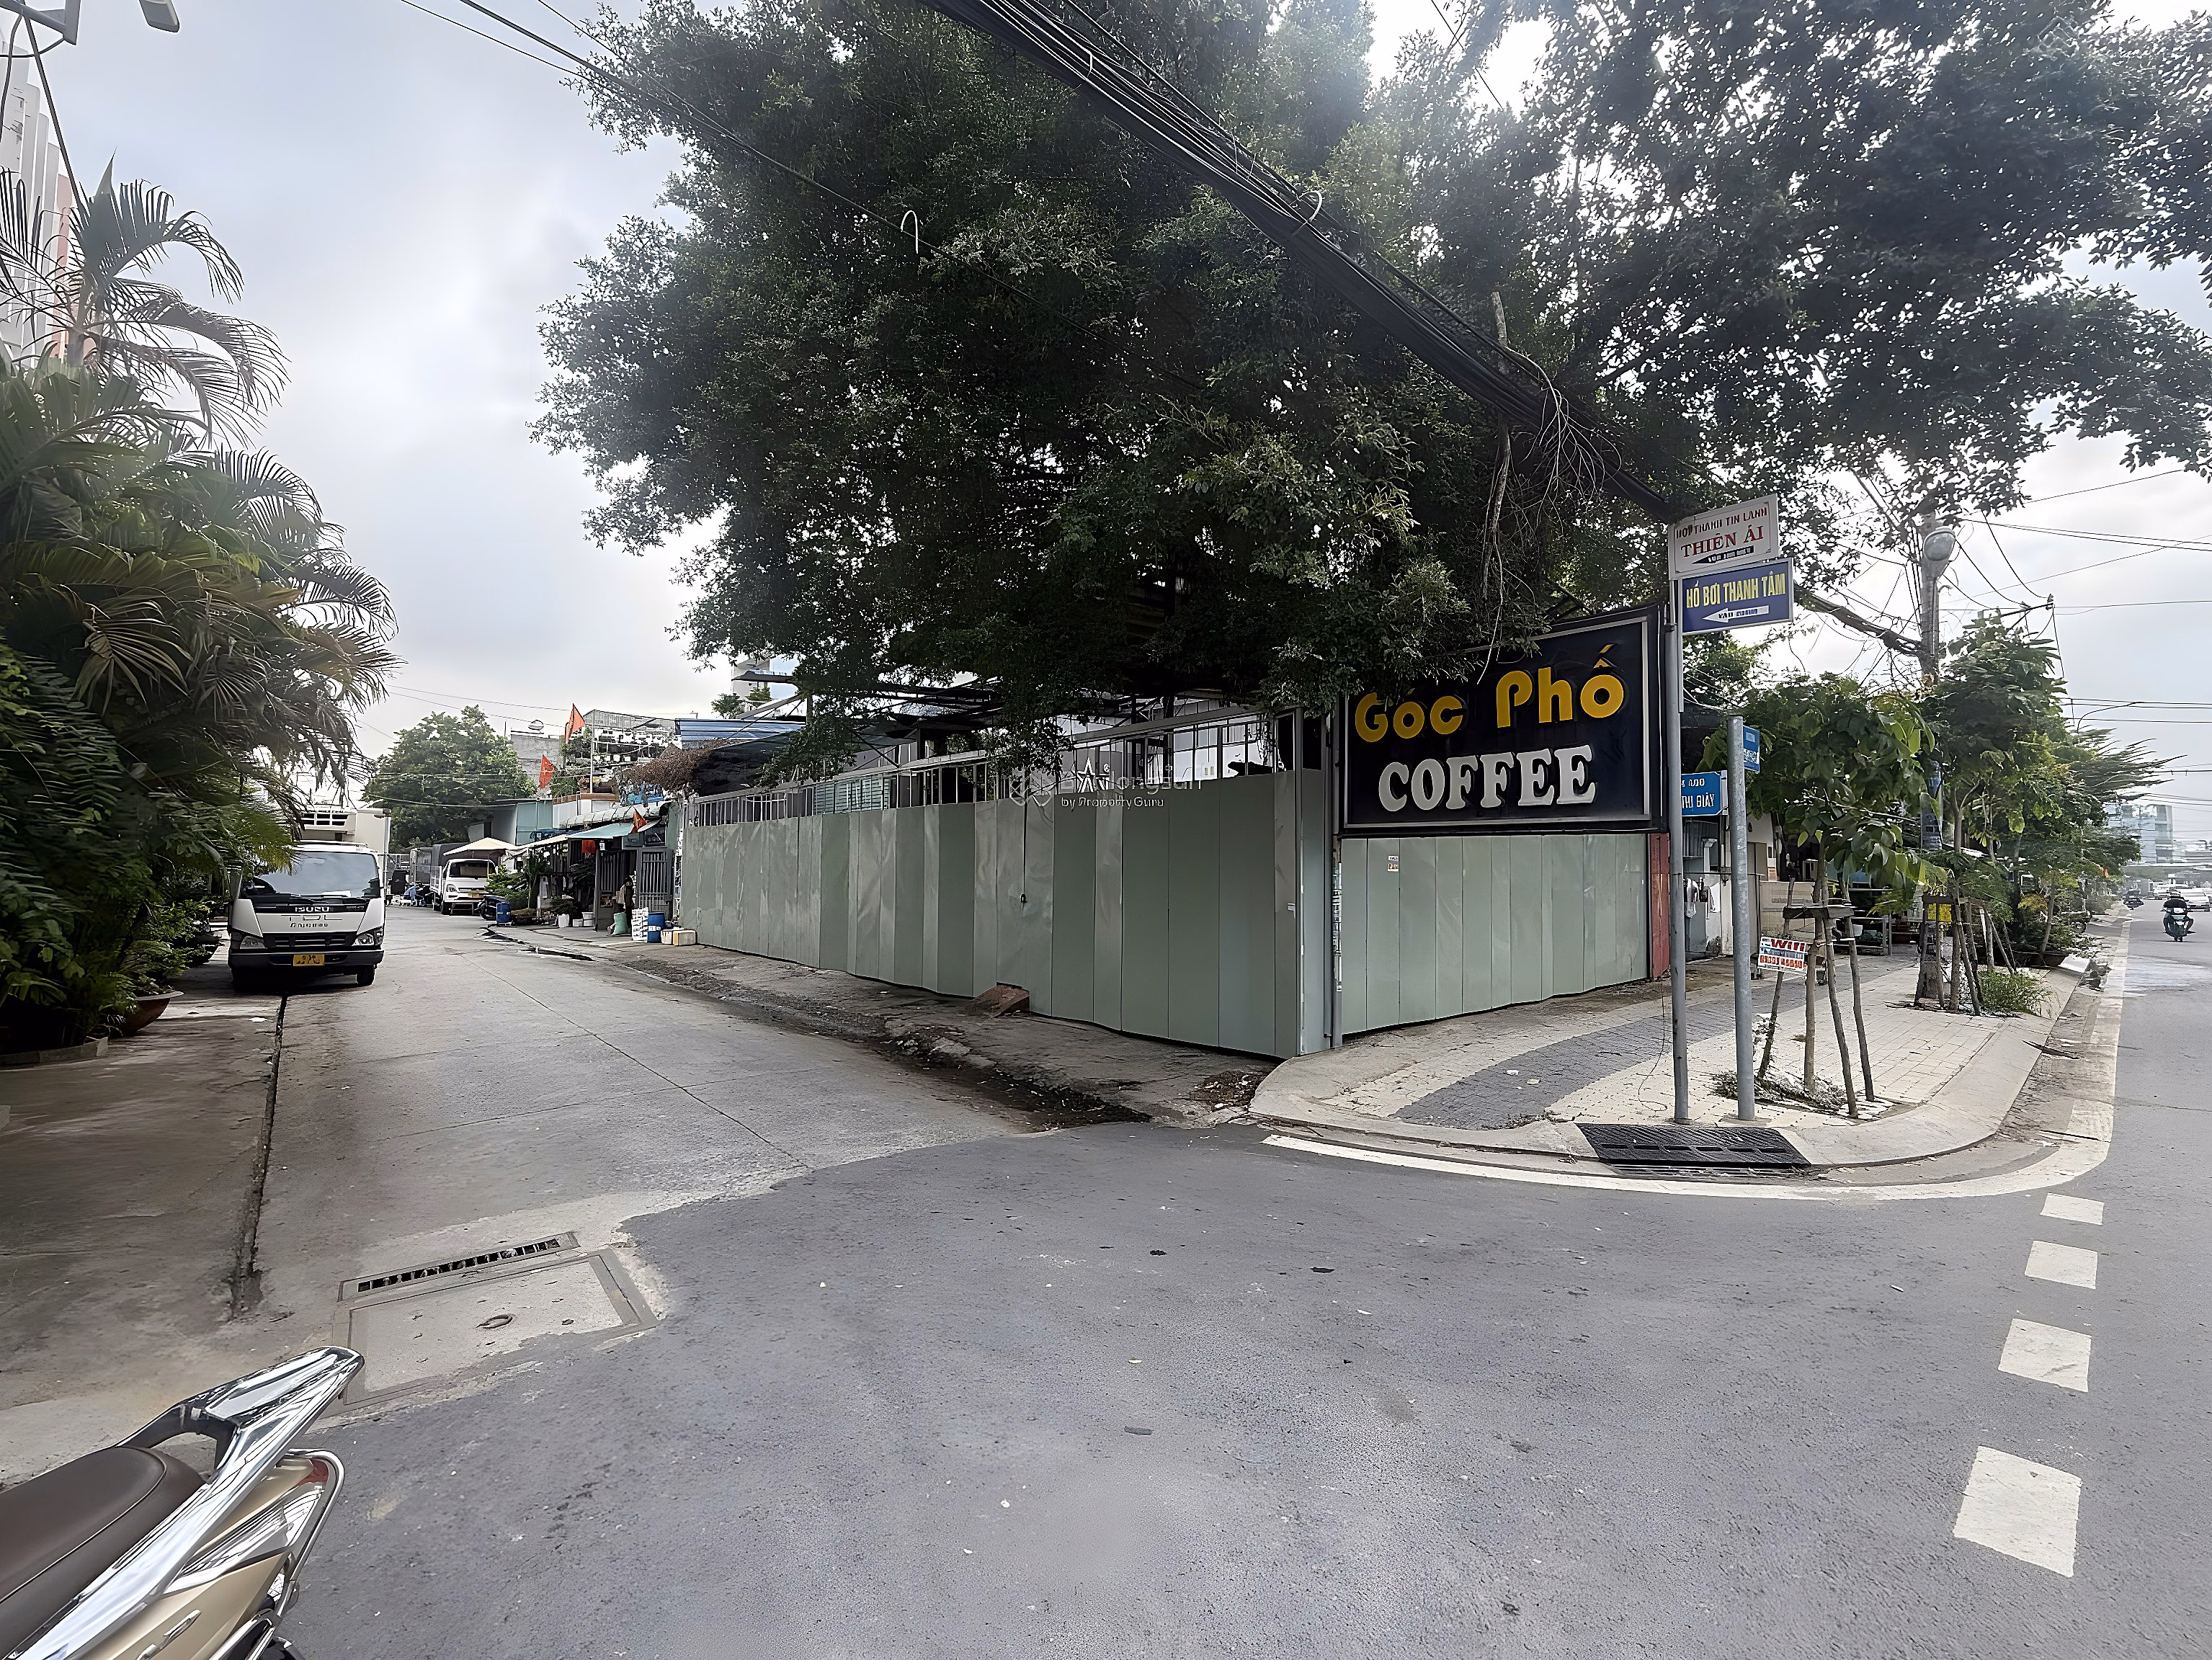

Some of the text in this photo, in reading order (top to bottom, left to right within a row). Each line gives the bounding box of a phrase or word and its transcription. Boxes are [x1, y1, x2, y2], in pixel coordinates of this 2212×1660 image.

[1726, 514, 1740, 526] TIN
[1723, 577, 1759, 603] THANH
[1761, 571, 1786, 597] TÂM
[1496, 643, 1625, 728] Phố
[1378, 744, 1597, 812] COFFEE
